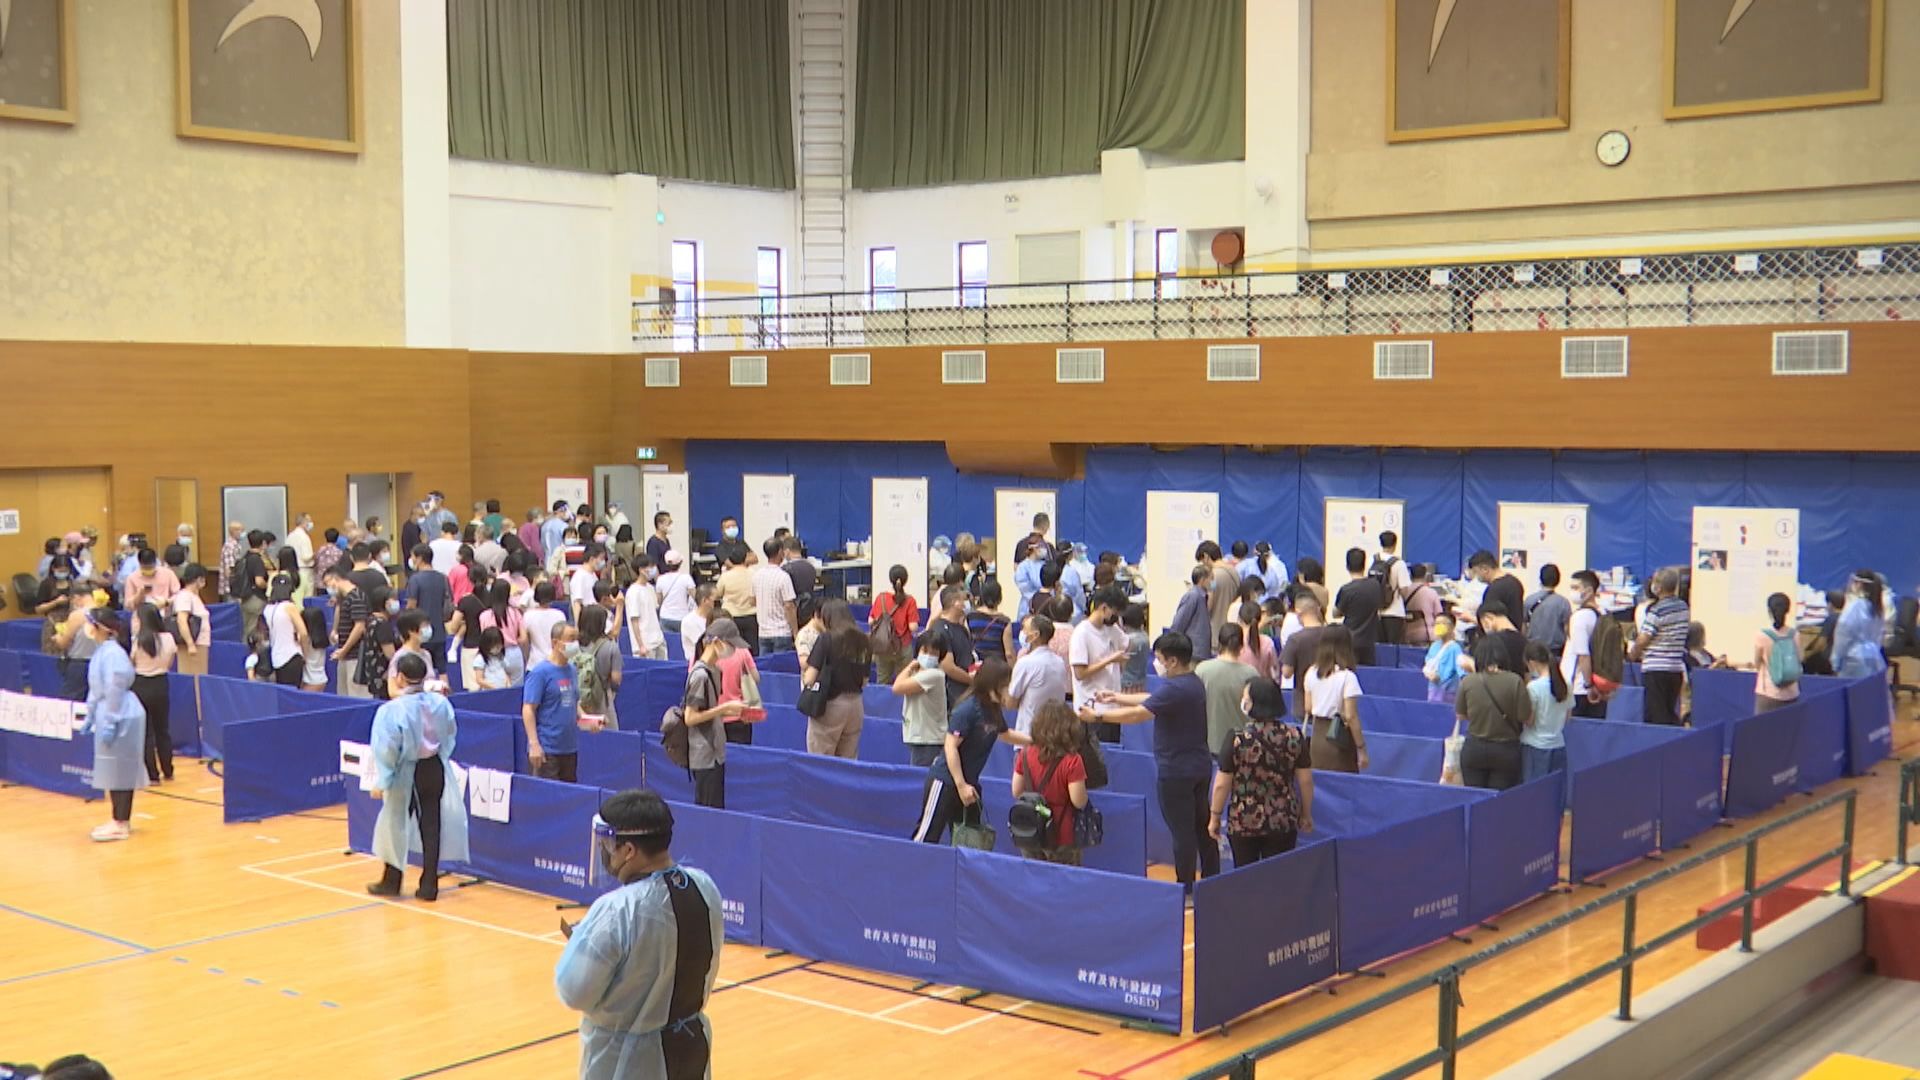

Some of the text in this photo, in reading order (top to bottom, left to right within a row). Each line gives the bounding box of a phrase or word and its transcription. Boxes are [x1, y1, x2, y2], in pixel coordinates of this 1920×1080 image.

[906, 947, 936, 964] DSEDJ
[1078, 967, 1162, 997] 教育及青年發展局
[1124, 991, 1160, 1011] DSEDJ
